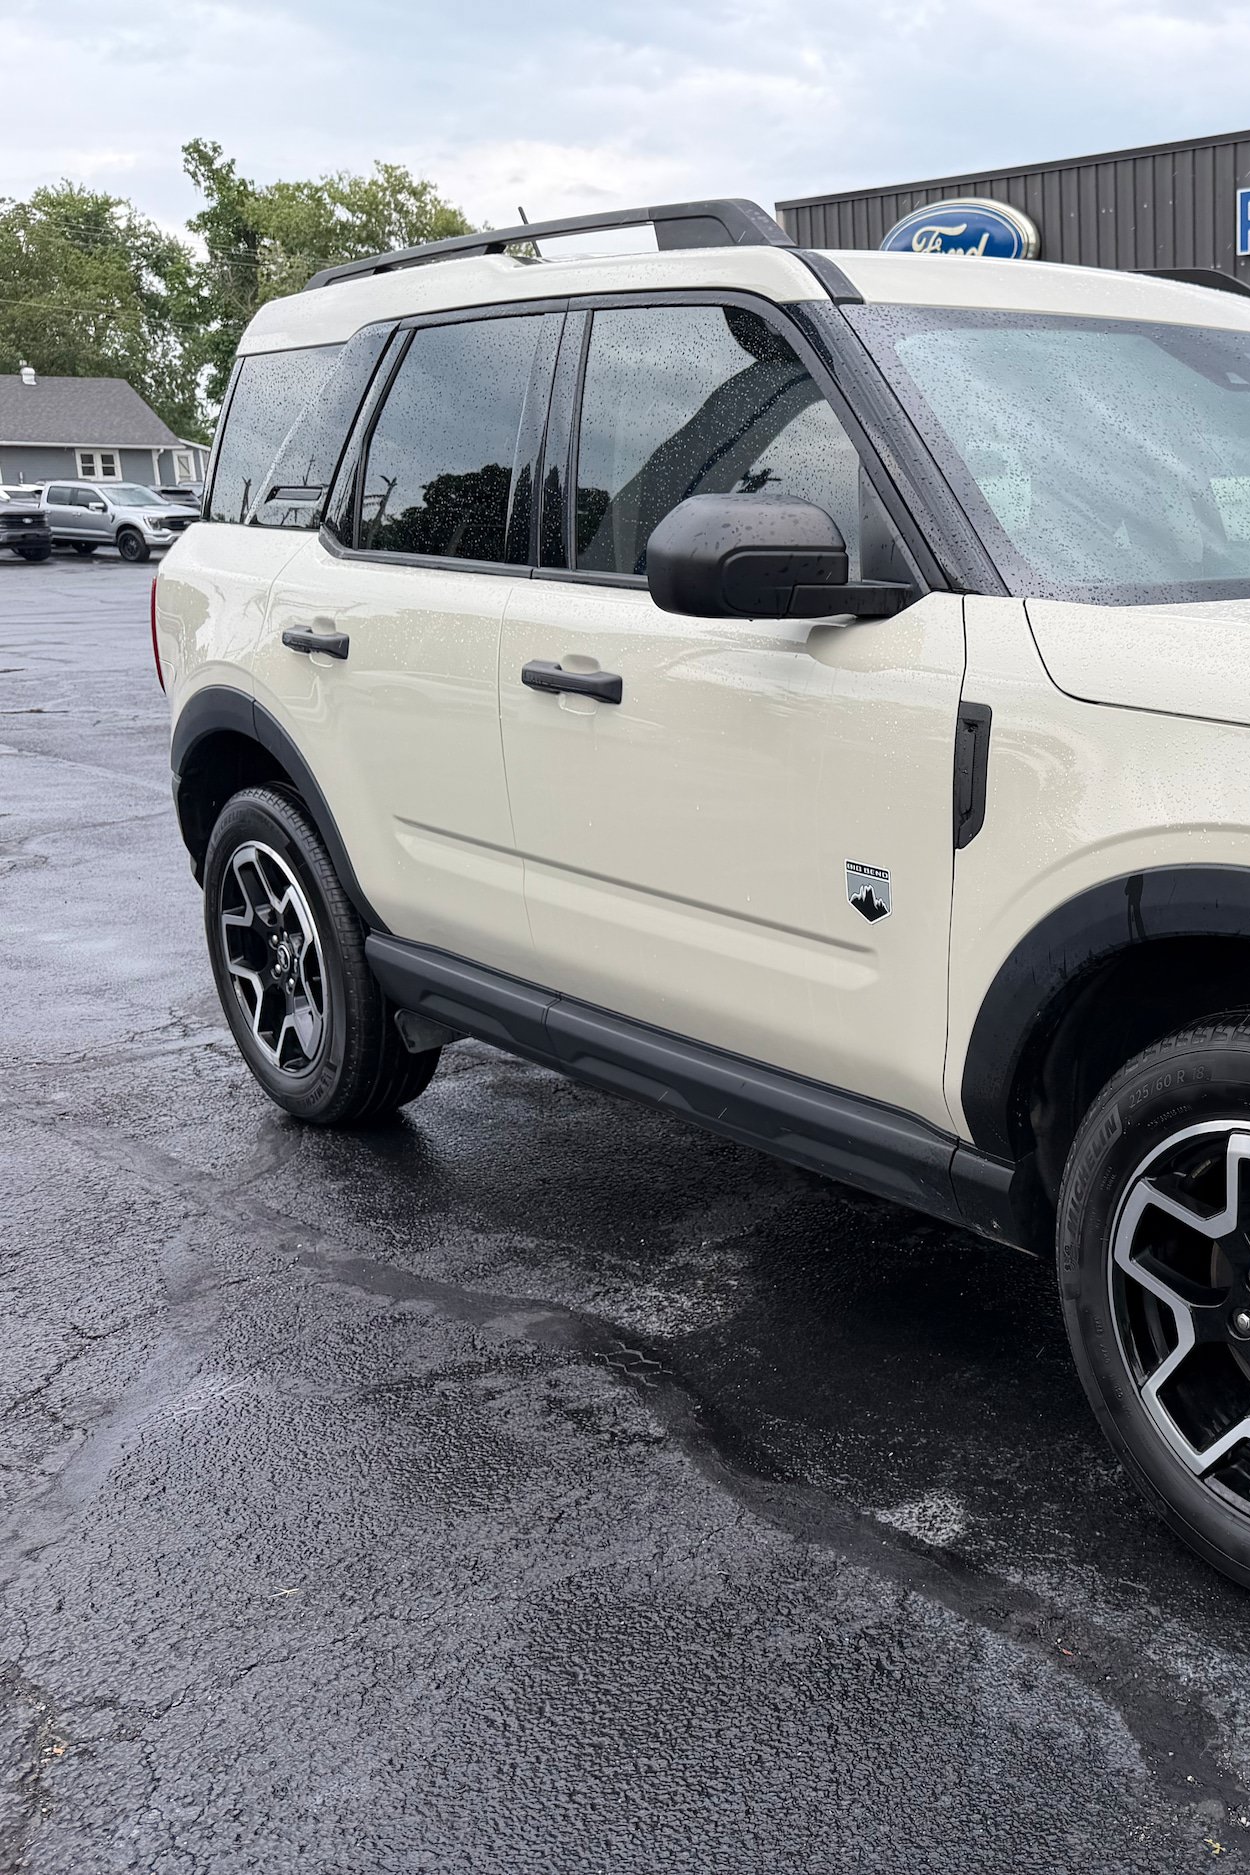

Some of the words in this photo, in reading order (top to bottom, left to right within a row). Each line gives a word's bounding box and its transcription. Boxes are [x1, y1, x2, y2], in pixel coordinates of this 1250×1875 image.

[846, 863, 862, 872] BIG
[863, 867, 888, 879] BEND
[1128, 1073, 1172, 1109] 225/60
[1177, 1069, 1185, 1084] R
[1192, 1066, 1204, 1081] 18
[1066, 1112, 1117, 1237] MICHELIN
